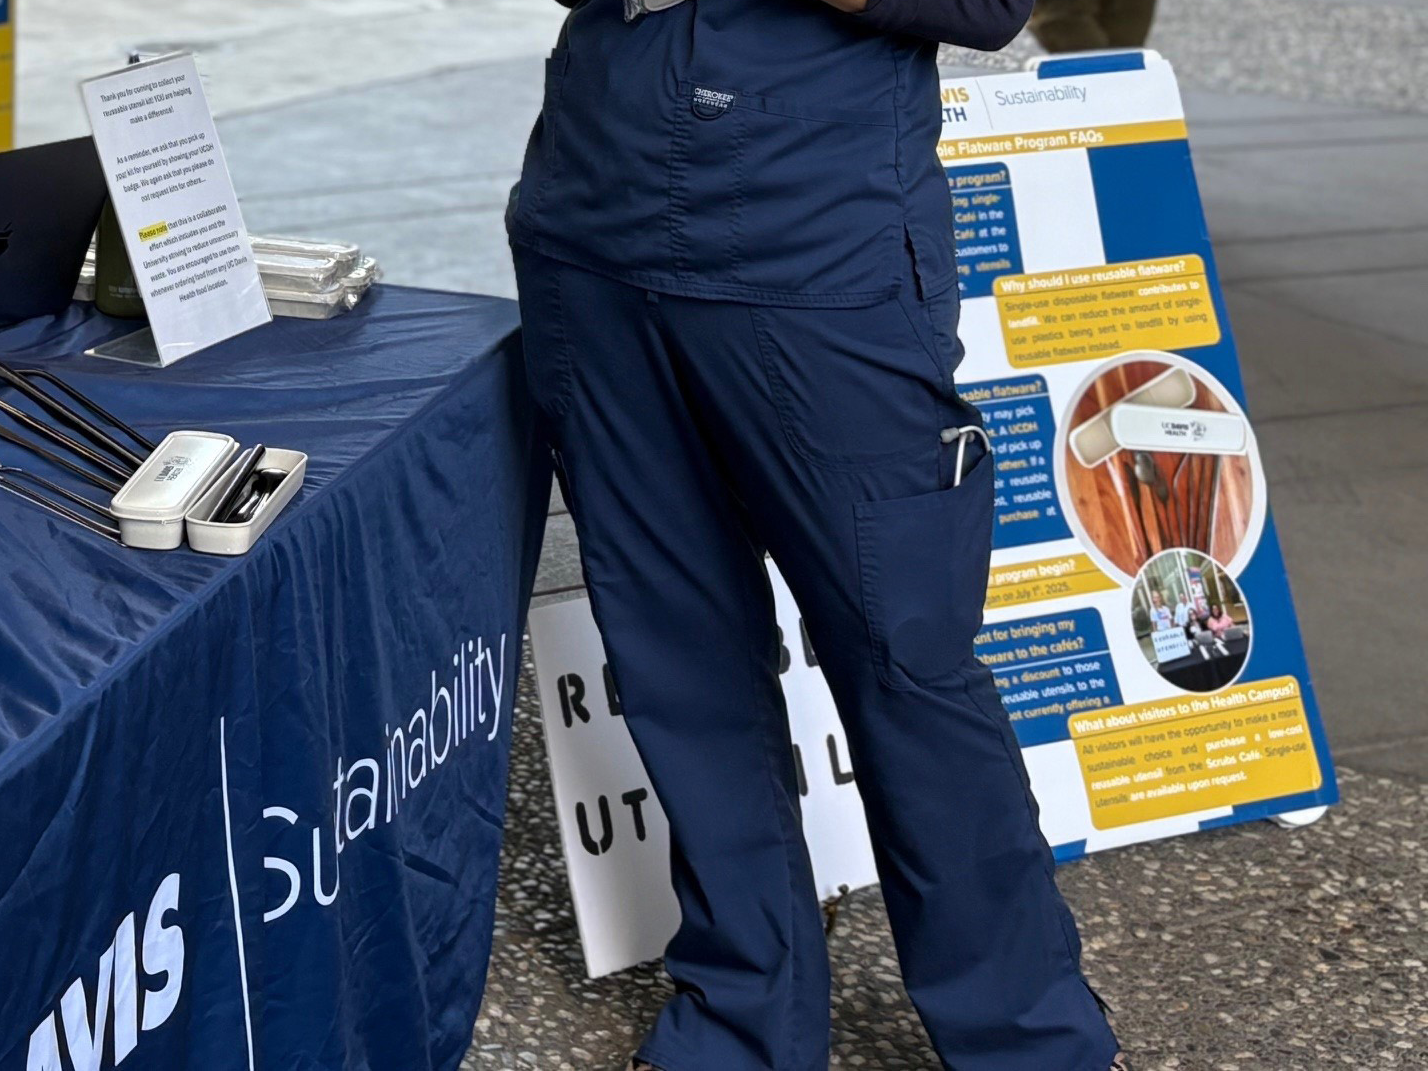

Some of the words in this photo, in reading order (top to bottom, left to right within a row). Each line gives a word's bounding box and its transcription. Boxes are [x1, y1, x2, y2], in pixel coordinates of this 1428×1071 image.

[994, 83, 1088, 107] Sustainability
[958, 141, 1012, 155] Flatware
[1013, 131, 1069, 153] Program
[1069, 130, 1104, 144] FAQs
[1000, 280, 1025, 293] Why
[1028, 275, 1063, 289] should
[1071, 275, 1090, 284] use
[1092, 267, 1136, 281] reusable
[1138, 260, 1185, 275] flatware?
[995, 568, 1037, 585] program
[1038, 559, 1075, 576] begin?
[993, 630, 1008, 641] for
[1010, 622, 1057, 638] bringing
[1074, 718, 1105, 733] What
[1106, 713, 1137, 727] about
[1138, 707, 1177, 721] visitors
[1191, 700, 1209, 712] the
[1211, 689, 1247, 708] Health
[1248, 683, 1294, 706] Campus?
[262, 633, 506, 923] Sutainability
[1091, 775, 1131, 790] reusable
[1133, 768, 1164, 782] utensil
[1165, 765, 1186, 775] from
[1188, 762, 1203, 771] the
[1206, 756, 1237, 769] Scrubs
[1239, 750, 1262, 762] Café.
[1265, 743, 1307, 757] Single-use
[1095, 794, 1129, 808] utensils
[1130, 792, 1146, 801] are
[1146, 783, 1186, 798] available
[1187, 779, 1211, 791] upon
[1210, 771, 1247, 785] request.
